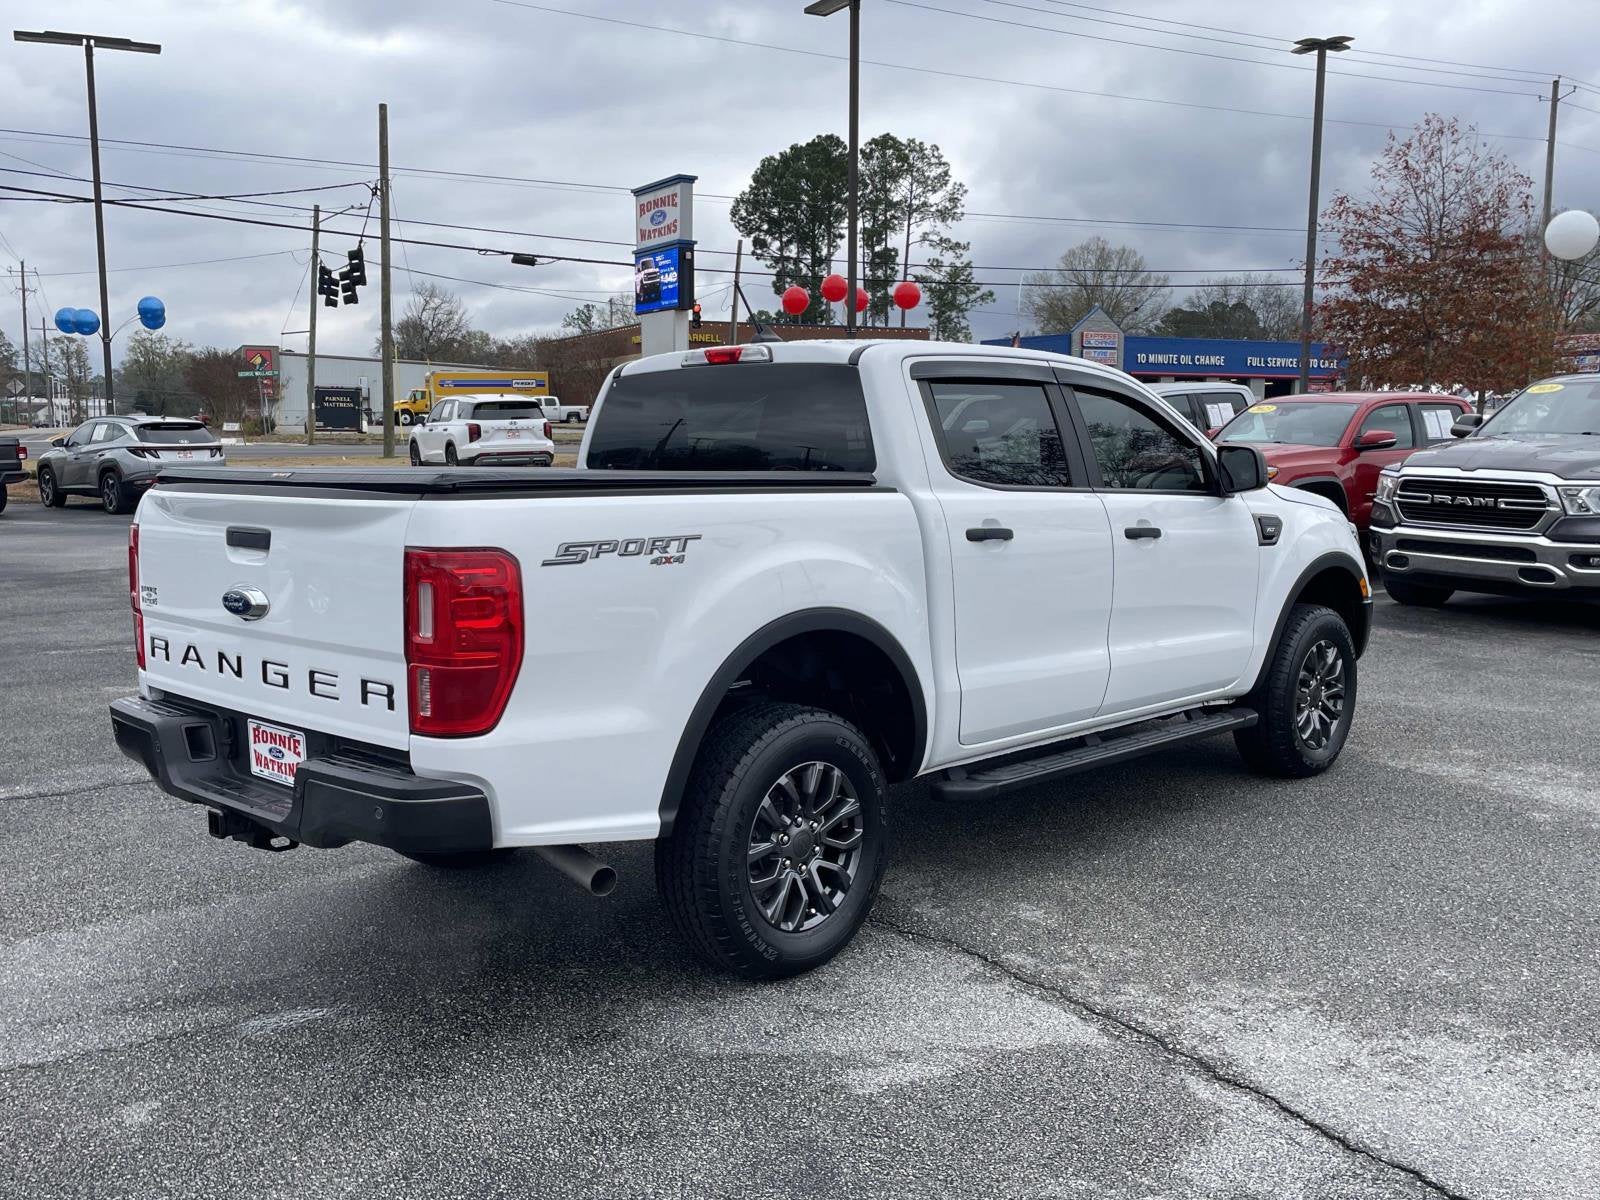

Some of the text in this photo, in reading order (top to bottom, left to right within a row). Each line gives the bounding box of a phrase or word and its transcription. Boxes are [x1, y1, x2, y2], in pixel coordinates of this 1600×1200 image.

[639, 192, 678, 218] RONNIE
[639, 218, 678, 242] WATKINS
[688, 332, 721, 343] ARNELL
[1137, 353, 1225, 366] 10 MINUTE OIL CHANGE
[1247, 356, 1266, 367] FULL
[1267, 357, 1298, 368] SERVICE
[1433, 494, 1495, 507] RAM
[541, 534, 702, 567] SPORT
[150, 636, 395, 712] RANGER
[252, 727, 302, 759] RONNIE
